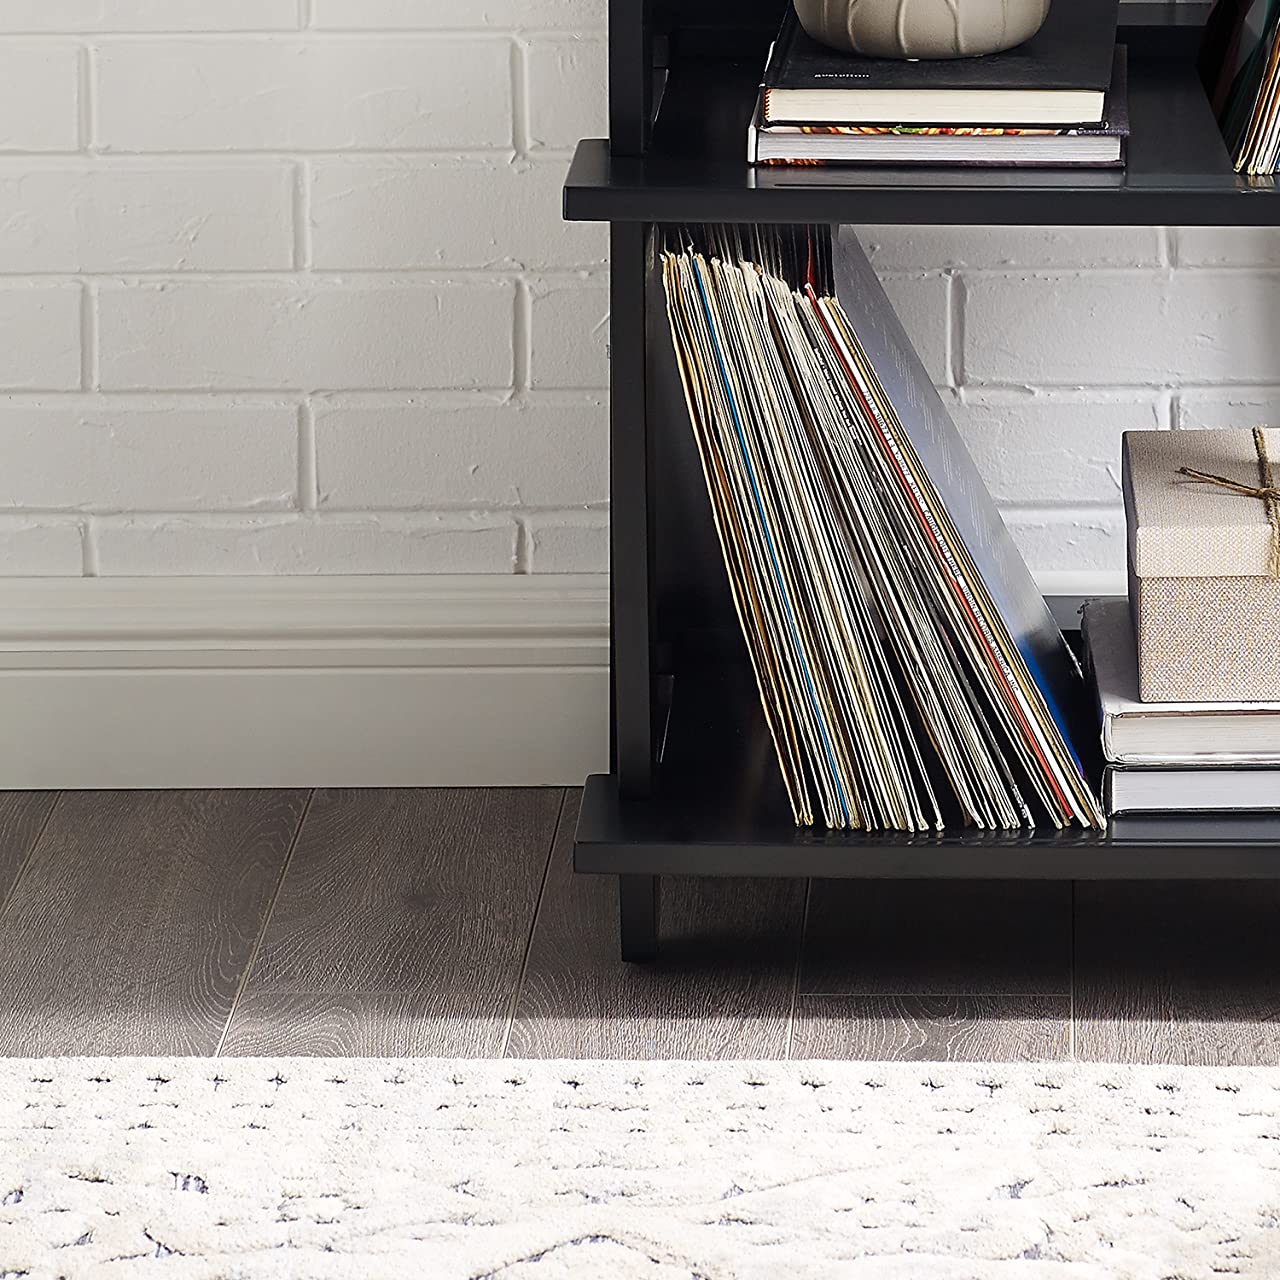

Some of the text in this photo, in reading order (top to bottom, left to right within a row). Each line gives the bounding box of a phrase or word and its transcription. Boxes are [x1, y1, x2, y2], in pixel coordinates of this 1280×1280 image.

[921, 508, 942, 539] CAUGHT
[937, 538, 950, 554] OUT
[945, 555, 962, 579] THERE
[960, 584, 978, 610] VIRGIN
[972, 609, 995, 645] RECORDS
